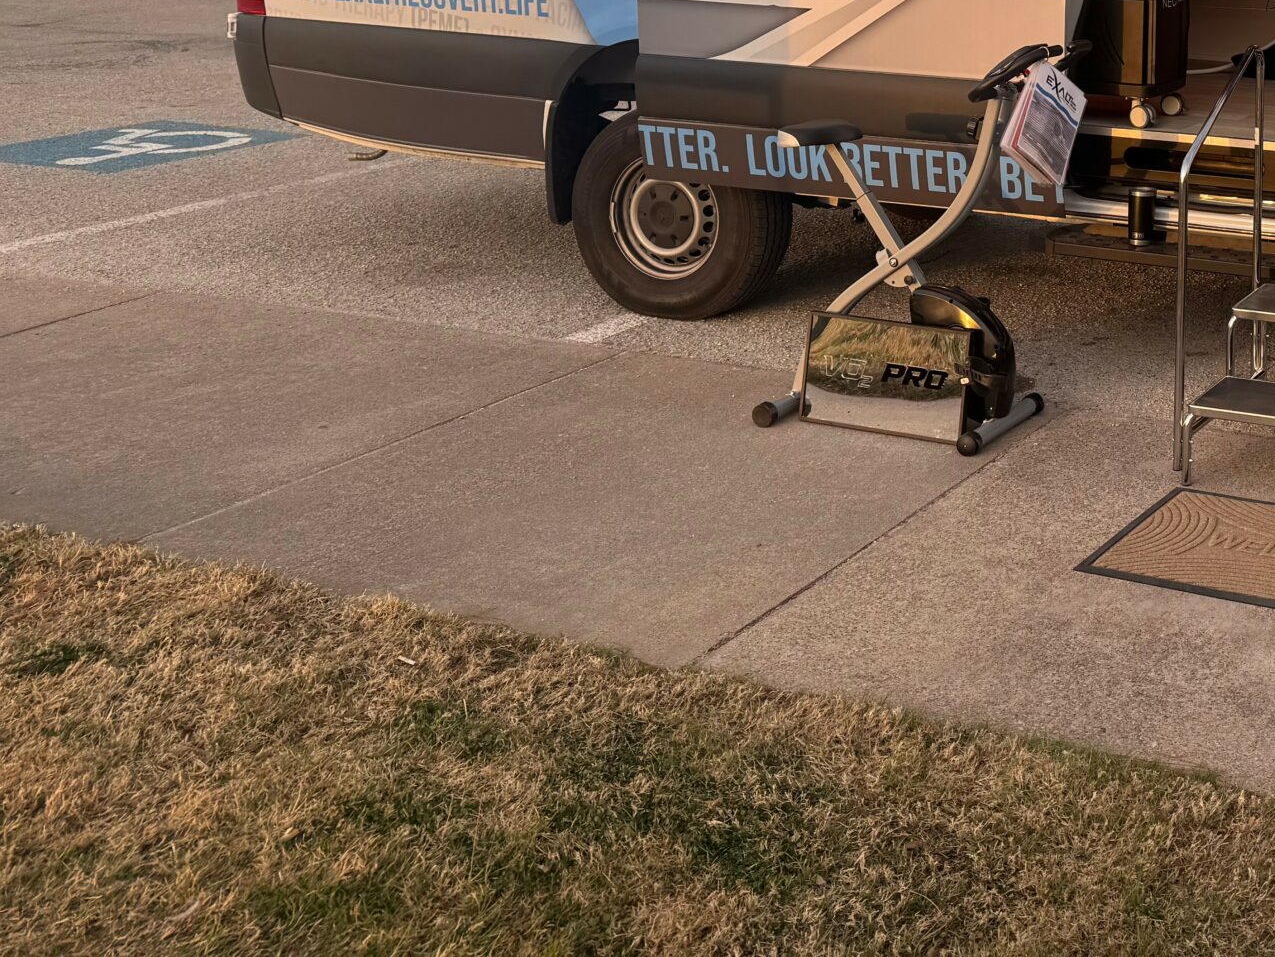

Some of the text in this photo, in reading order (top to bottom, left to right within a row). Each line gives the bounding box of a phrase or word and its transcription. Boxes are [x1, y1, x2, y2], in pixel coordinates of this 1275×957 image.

[638, 124, 729, 173] TTER.
[745, 133, 834, 183] LOOK
[841, 142, 967, 195] BETTER
[1000, 156, 1064, 204] BE
[880, 362, 949, 390] PRO
